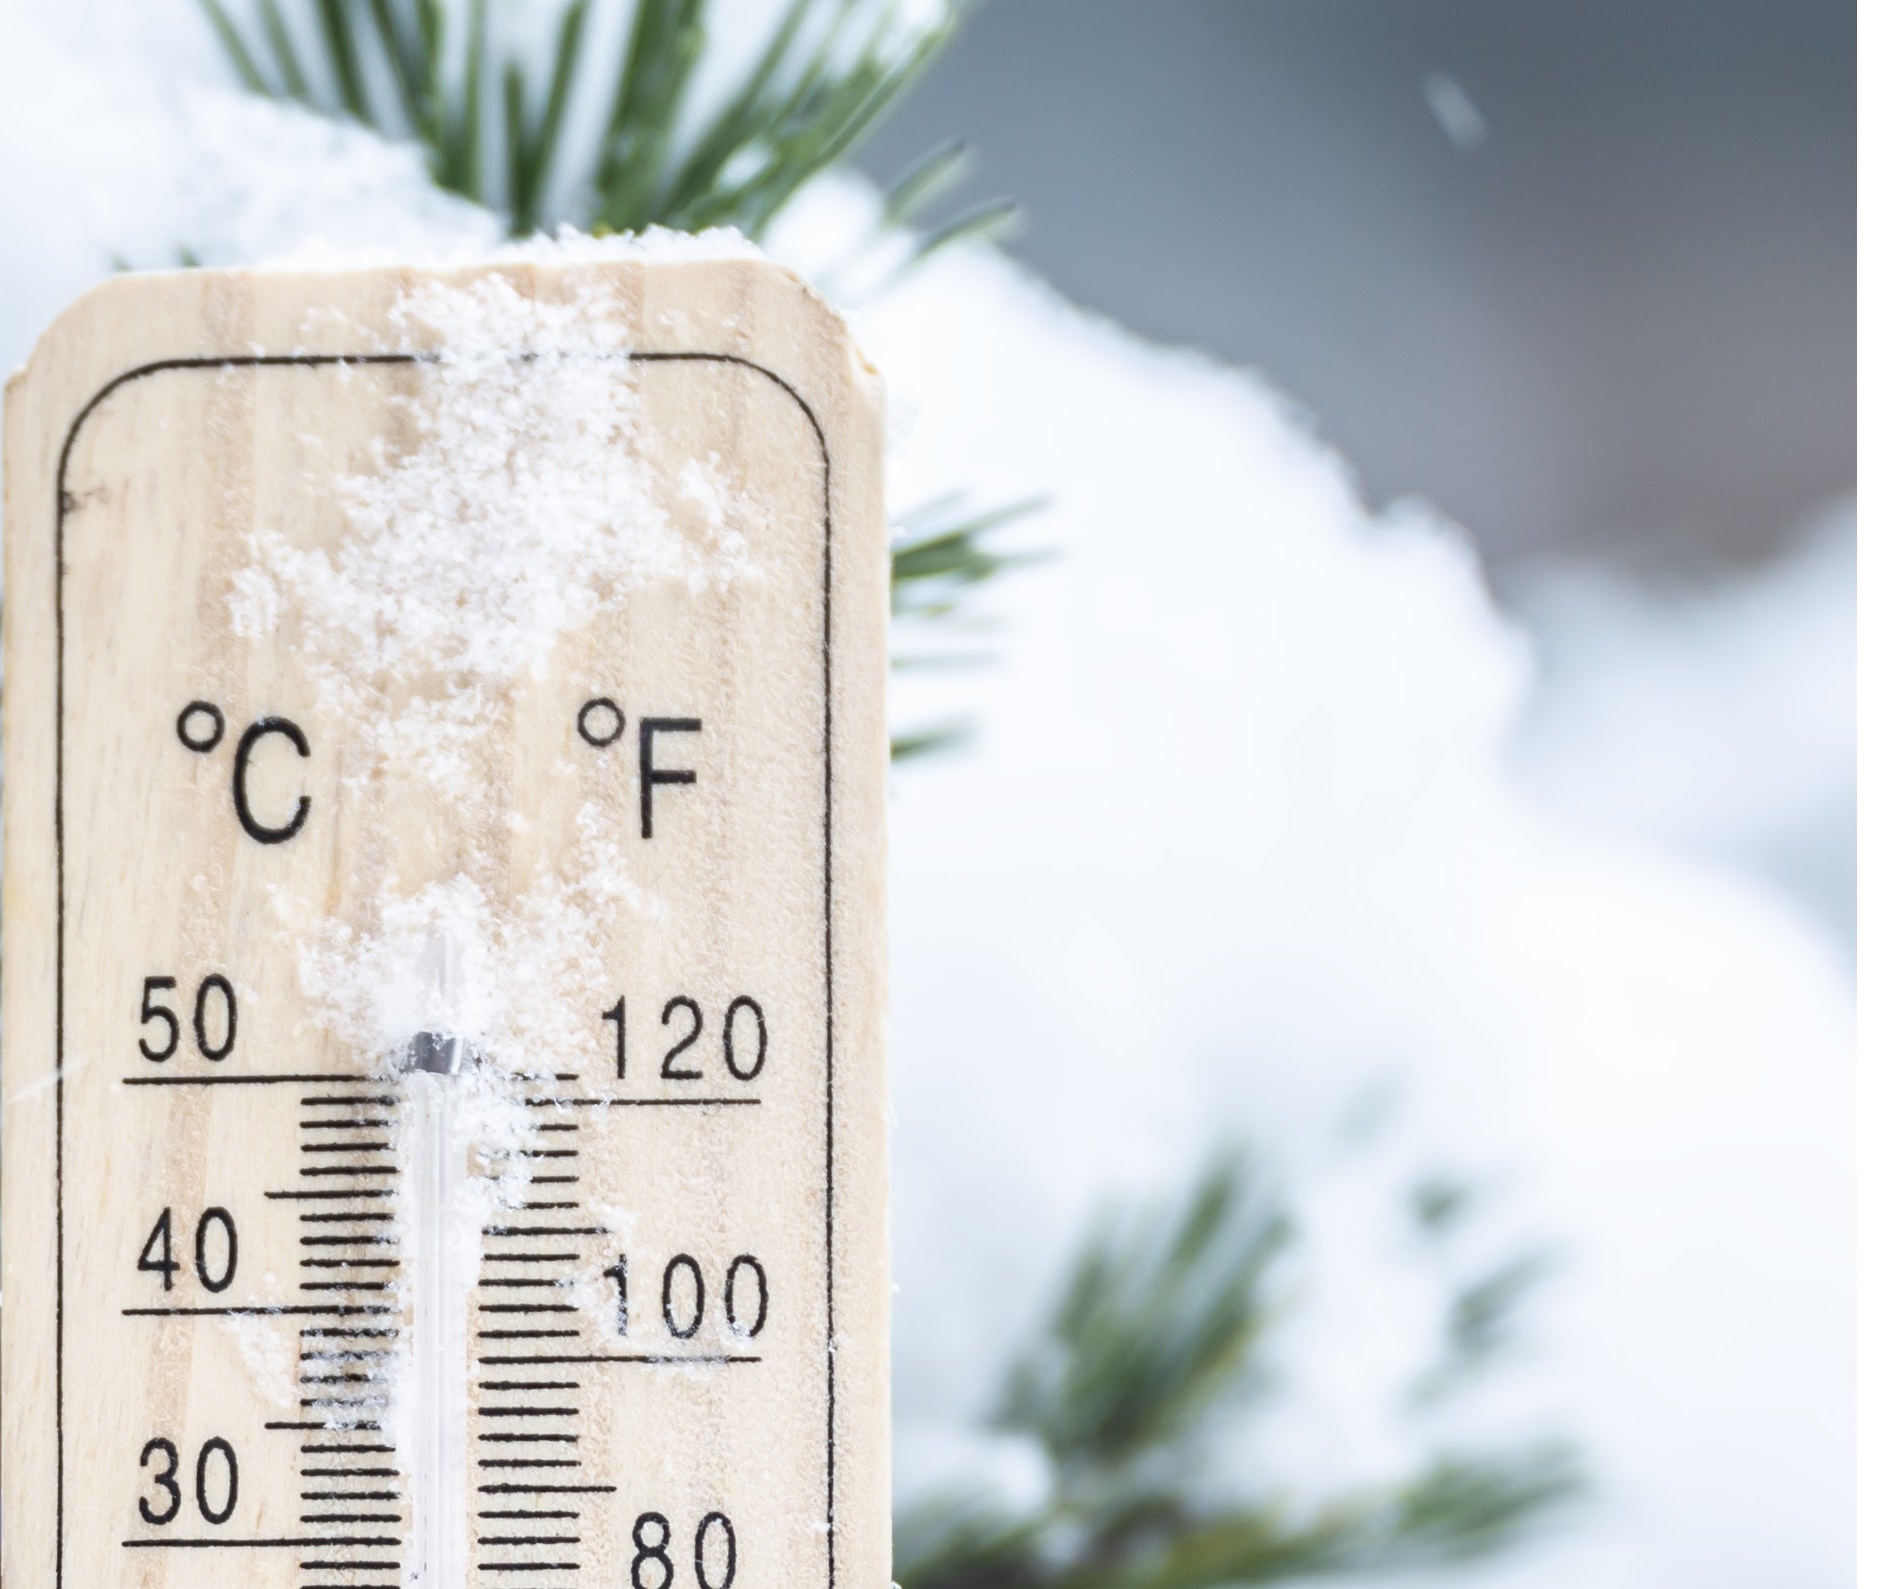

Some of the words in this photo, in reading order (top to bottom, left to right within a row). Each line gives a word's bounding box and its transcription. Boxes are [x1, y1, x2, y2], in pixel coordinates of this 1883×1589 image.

[138, 973, 238, 1063] 50
[601, 995, 768, 1082] 120
[136, 1206, 238, 1294] 40
[602, 1253, 769, 1340] 100
[138, 1436, 239, 1526] 30
